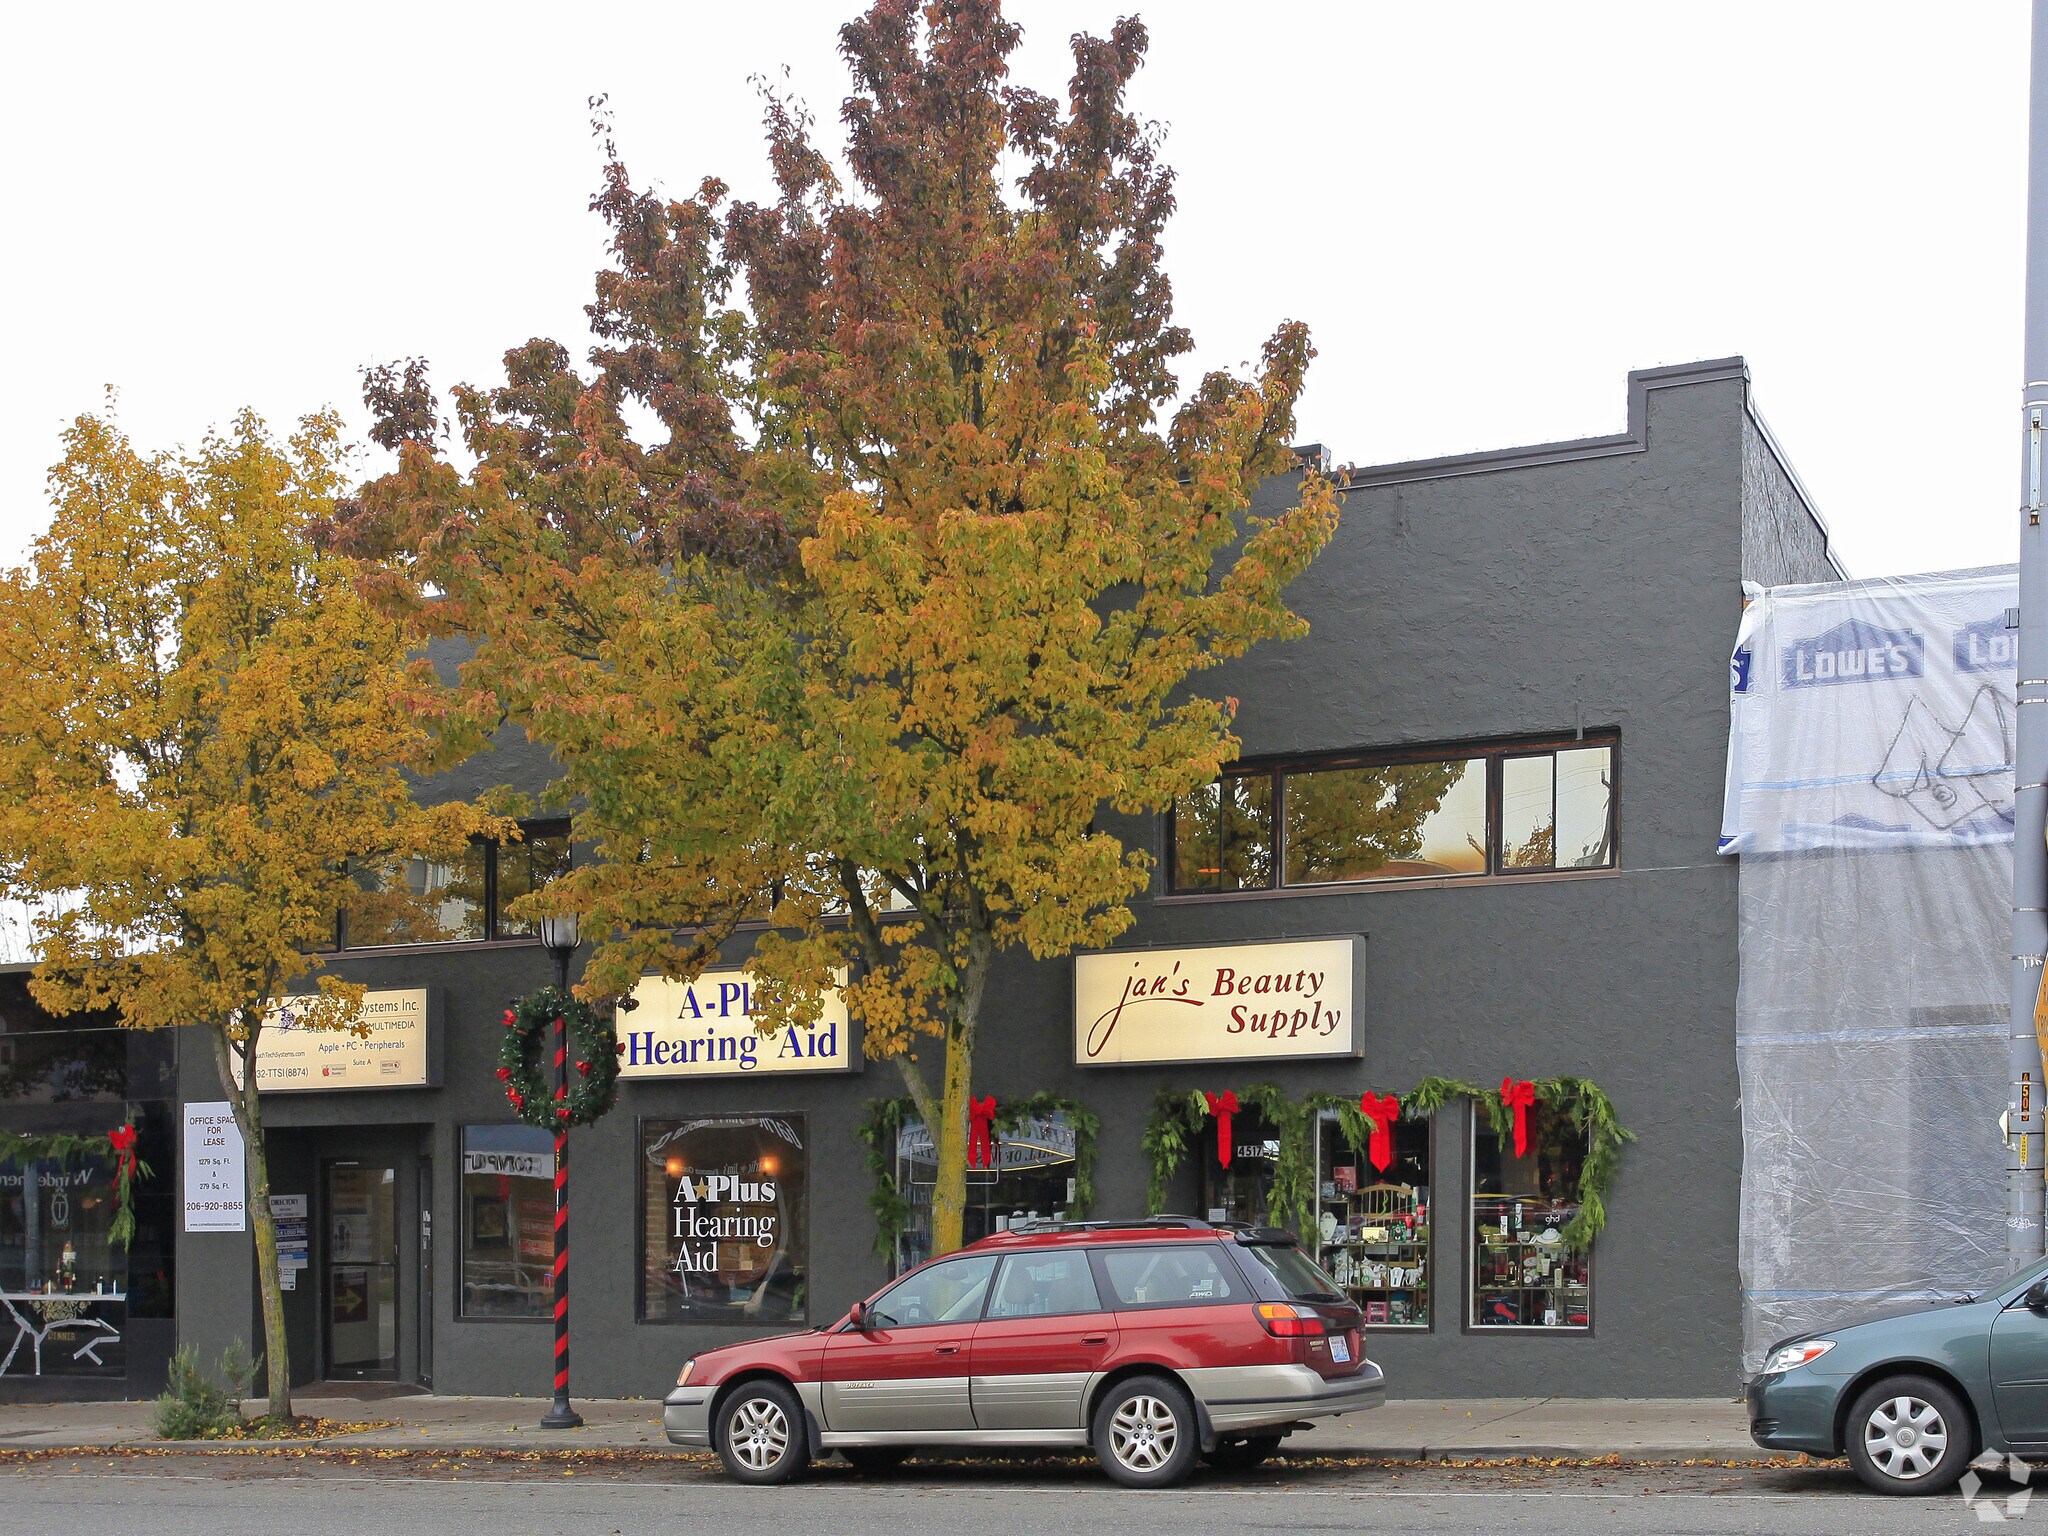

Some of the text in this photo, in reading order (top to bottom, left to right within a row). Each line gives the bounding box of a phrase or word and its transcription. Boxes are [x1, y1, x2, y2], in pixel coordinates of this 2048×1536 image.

[1796, 641, 1909, 680] LOWE'S
[402, 998, 419, 1011] Inc.
[677, 982, 780, 1019] A-Pl
[1087, 960, 1325, 1057] jan's Beauty
[368, 1020, 415, 1031] MULTIMEDIA
[1226, 1000, 1341, 1038] Supply
[318, 1039, 405, 1053] Apple PC Peripherals
[627, 1022, 838, 1070] Hearing Aid
[256, 1051, 305, 1059] uchTechSystems.com
[189, 1116, 236, 1125] OFFICE SPAC
[203, 1138, 225, 1146] LEASE
[1239, 1146, 1262, 1156] 4517
[186, 1202, 243, 1211] 206-920-8855
[1545, 1214, 1560, 1225] ghd
[673, 1206, 776, 1248] Hearing
[673, 1241, 719, 1272] Aid
[48, 1331, 76, 1341] DINNER
